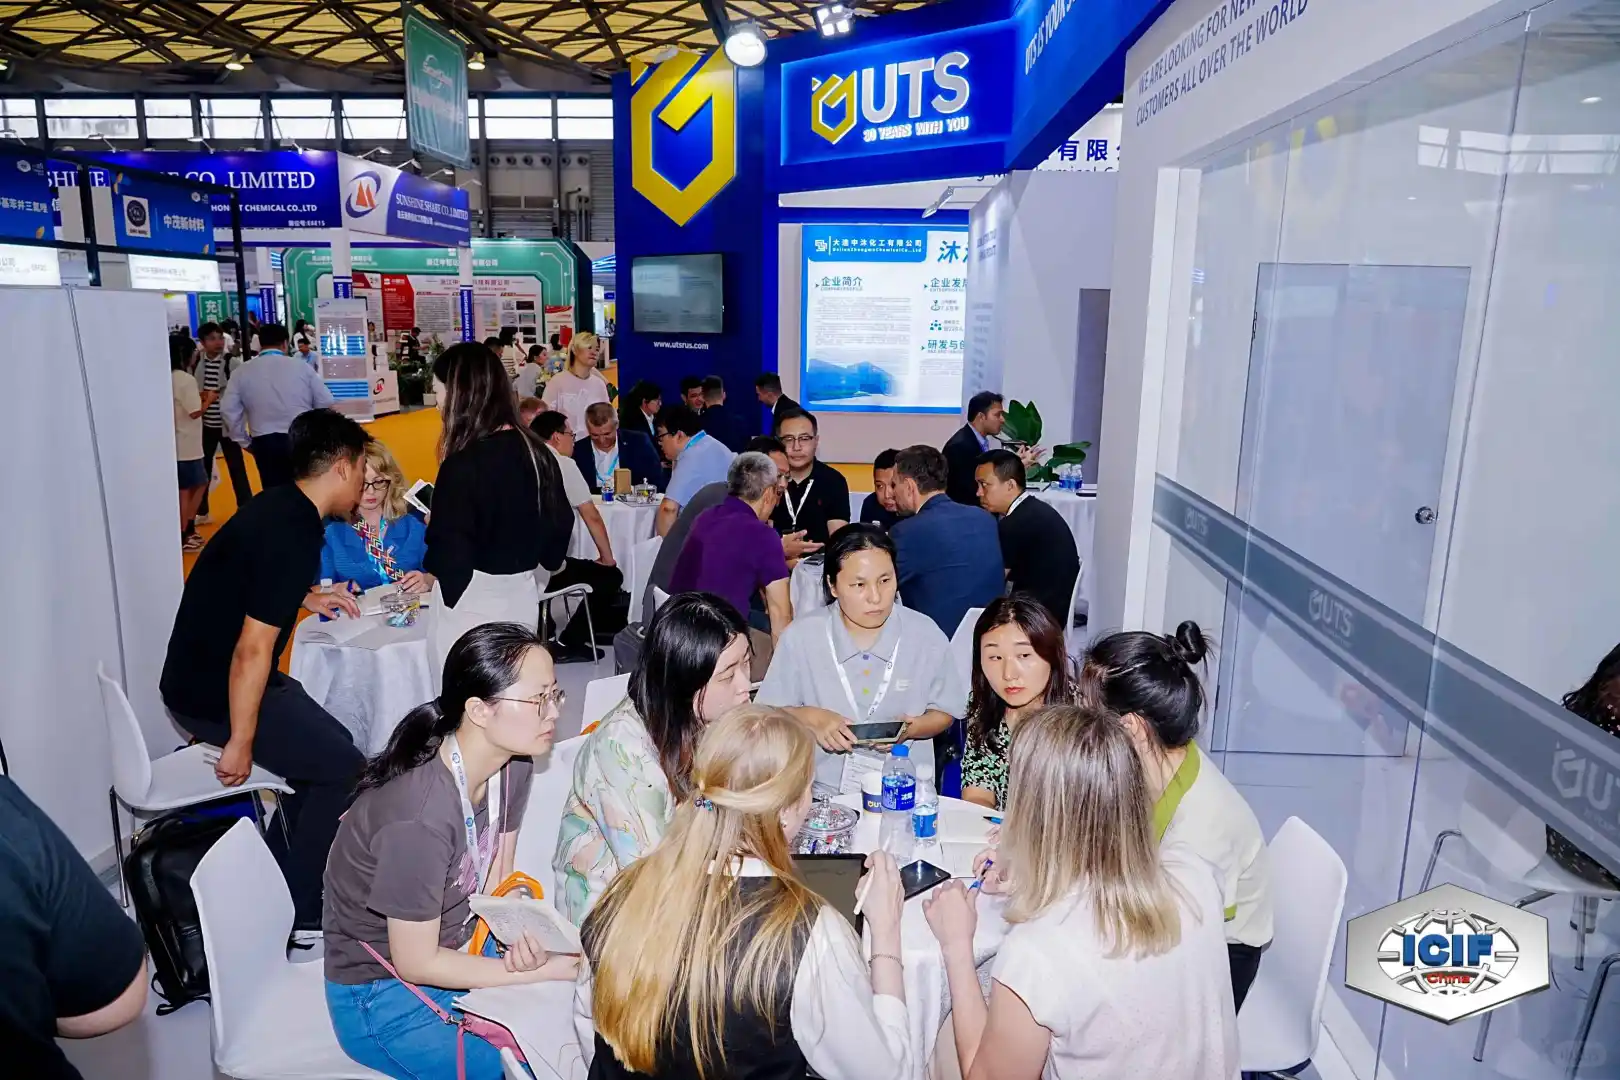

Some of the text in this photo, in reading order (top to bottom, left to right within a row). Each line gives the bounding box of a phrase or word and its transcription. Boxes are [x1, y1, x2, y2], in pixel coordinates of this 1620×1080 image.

[1136, 0, 1308, 126] CUSTOMERS ALL OVER THE WORLD
[1138, 71, 1149, 97] WE
[1150, 61, 1163, 87] ARE
[1164, 23, 1204, 76] LOOKING
[1206, 5, 1227, 42] FOR
[861, 51, 970, 124] UTS
[878, 124, 912, 140] YEARS
[915, 121, 943, 136] WITH
[946, 116, 969, 132] YOU
[245, 204, 286, 212] CHEMICAL
[937, 240, 968, 263] 沐
[821, 276, 863, 287] 企业简介
[653, 341, 709, 350] www.utsrus.com
[1322, 594, 1353, 637] UTS
